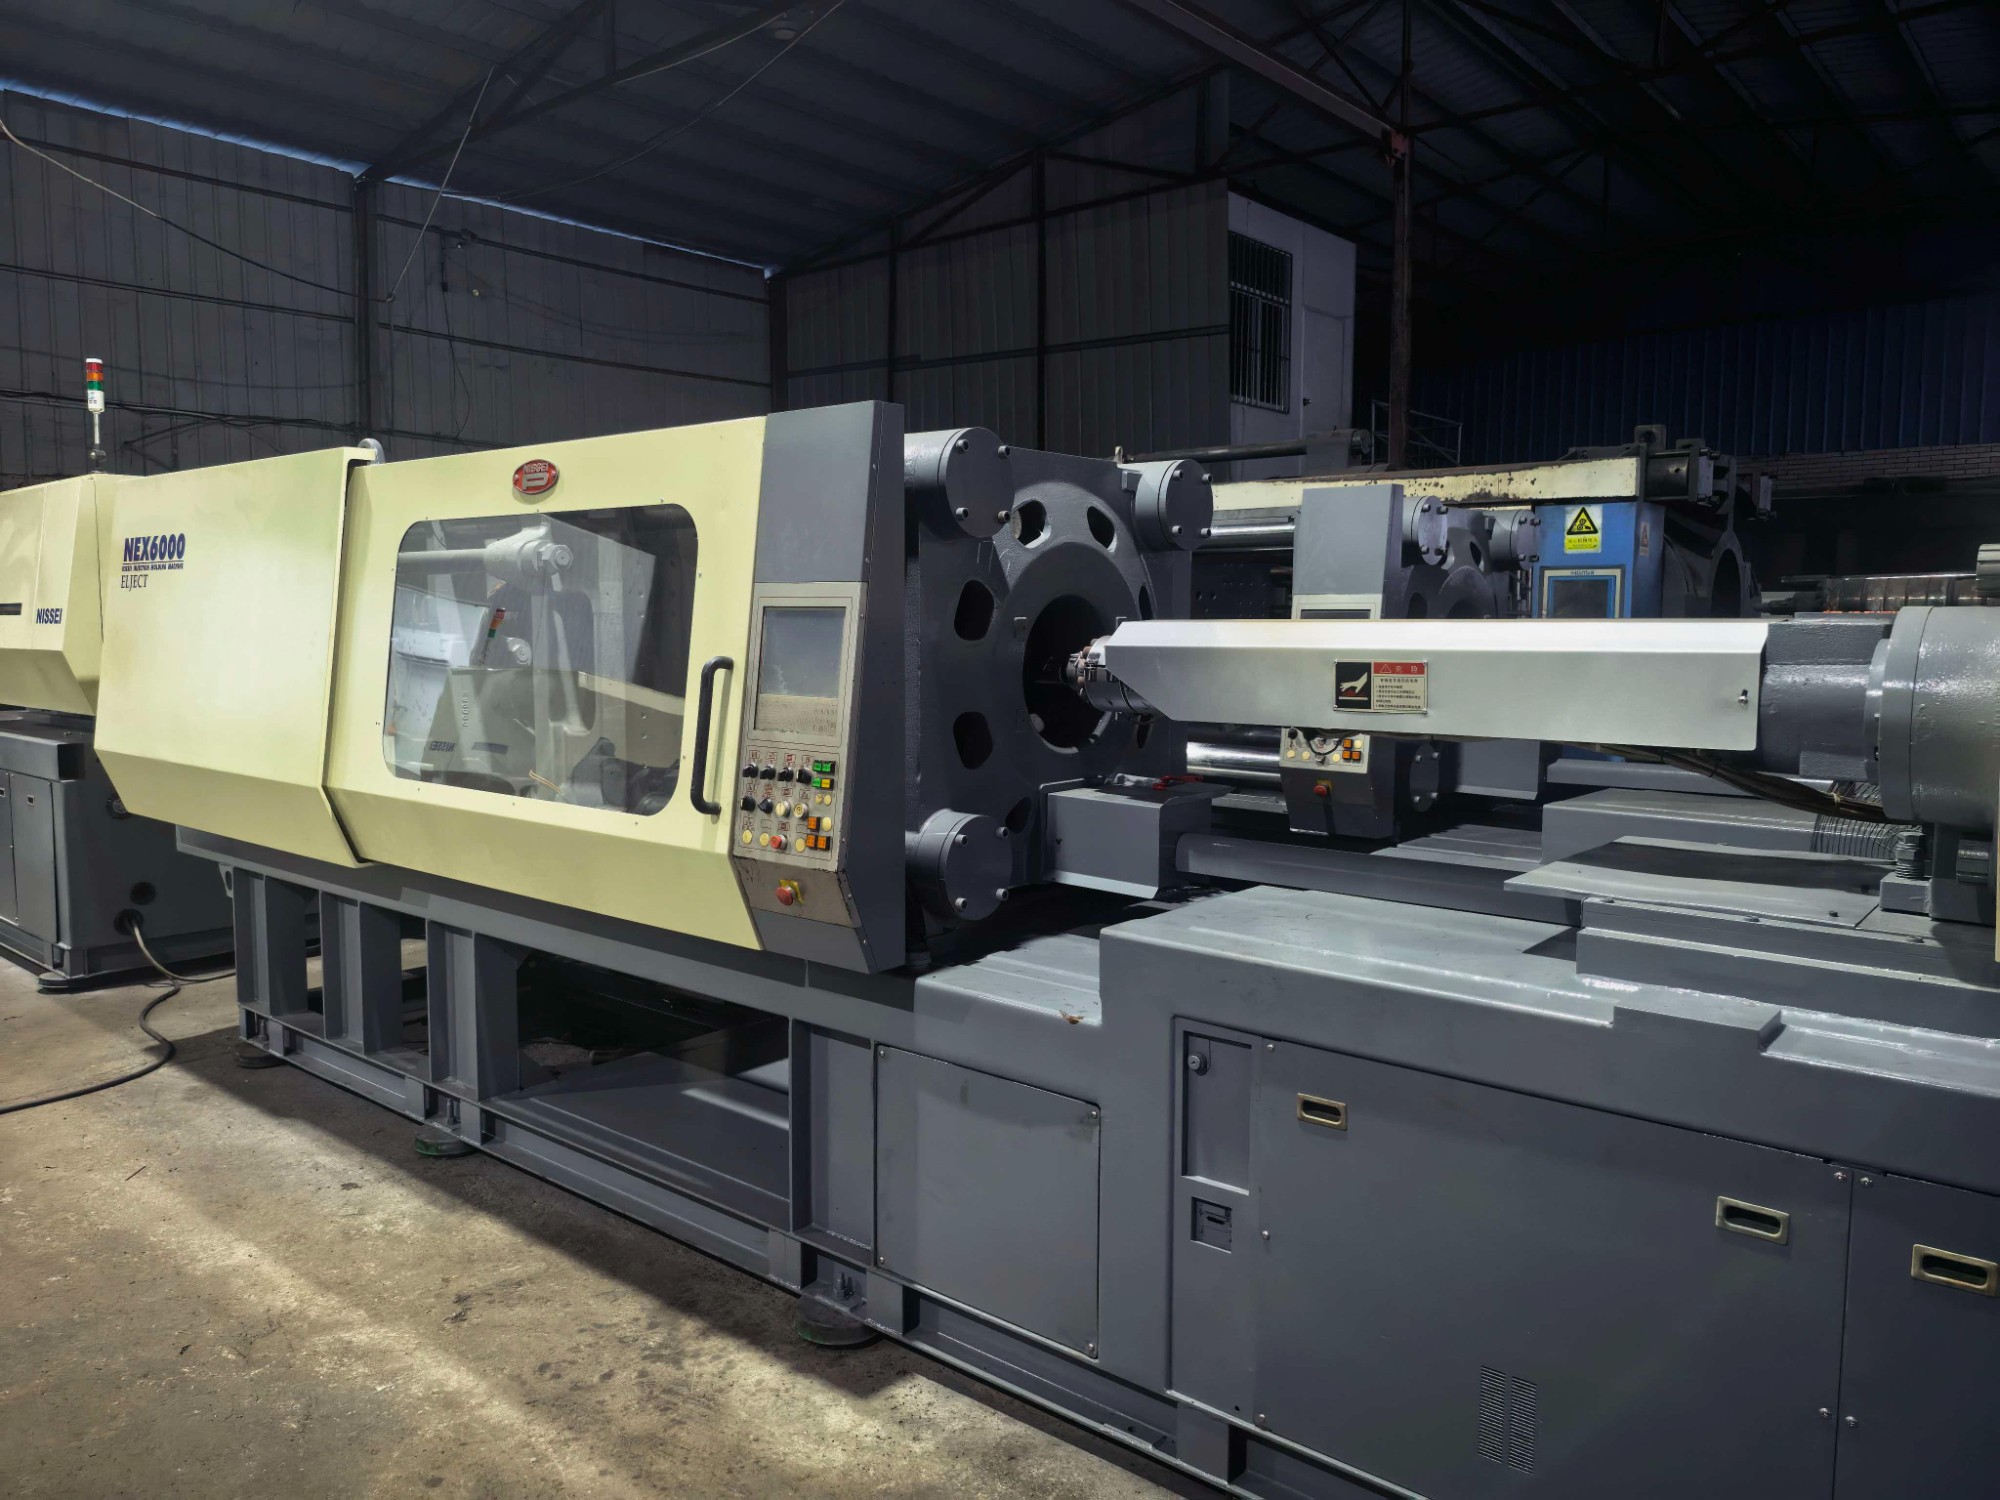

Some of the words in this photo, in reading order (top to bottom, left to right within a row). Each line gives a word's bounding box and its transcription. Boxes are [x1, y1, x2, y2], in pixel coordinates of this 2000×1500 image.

[123, 533, 186, 562] NEX6000
[120, 574, 149, 592] ELJECT
[36, 608, 63, 624] NISSEI
